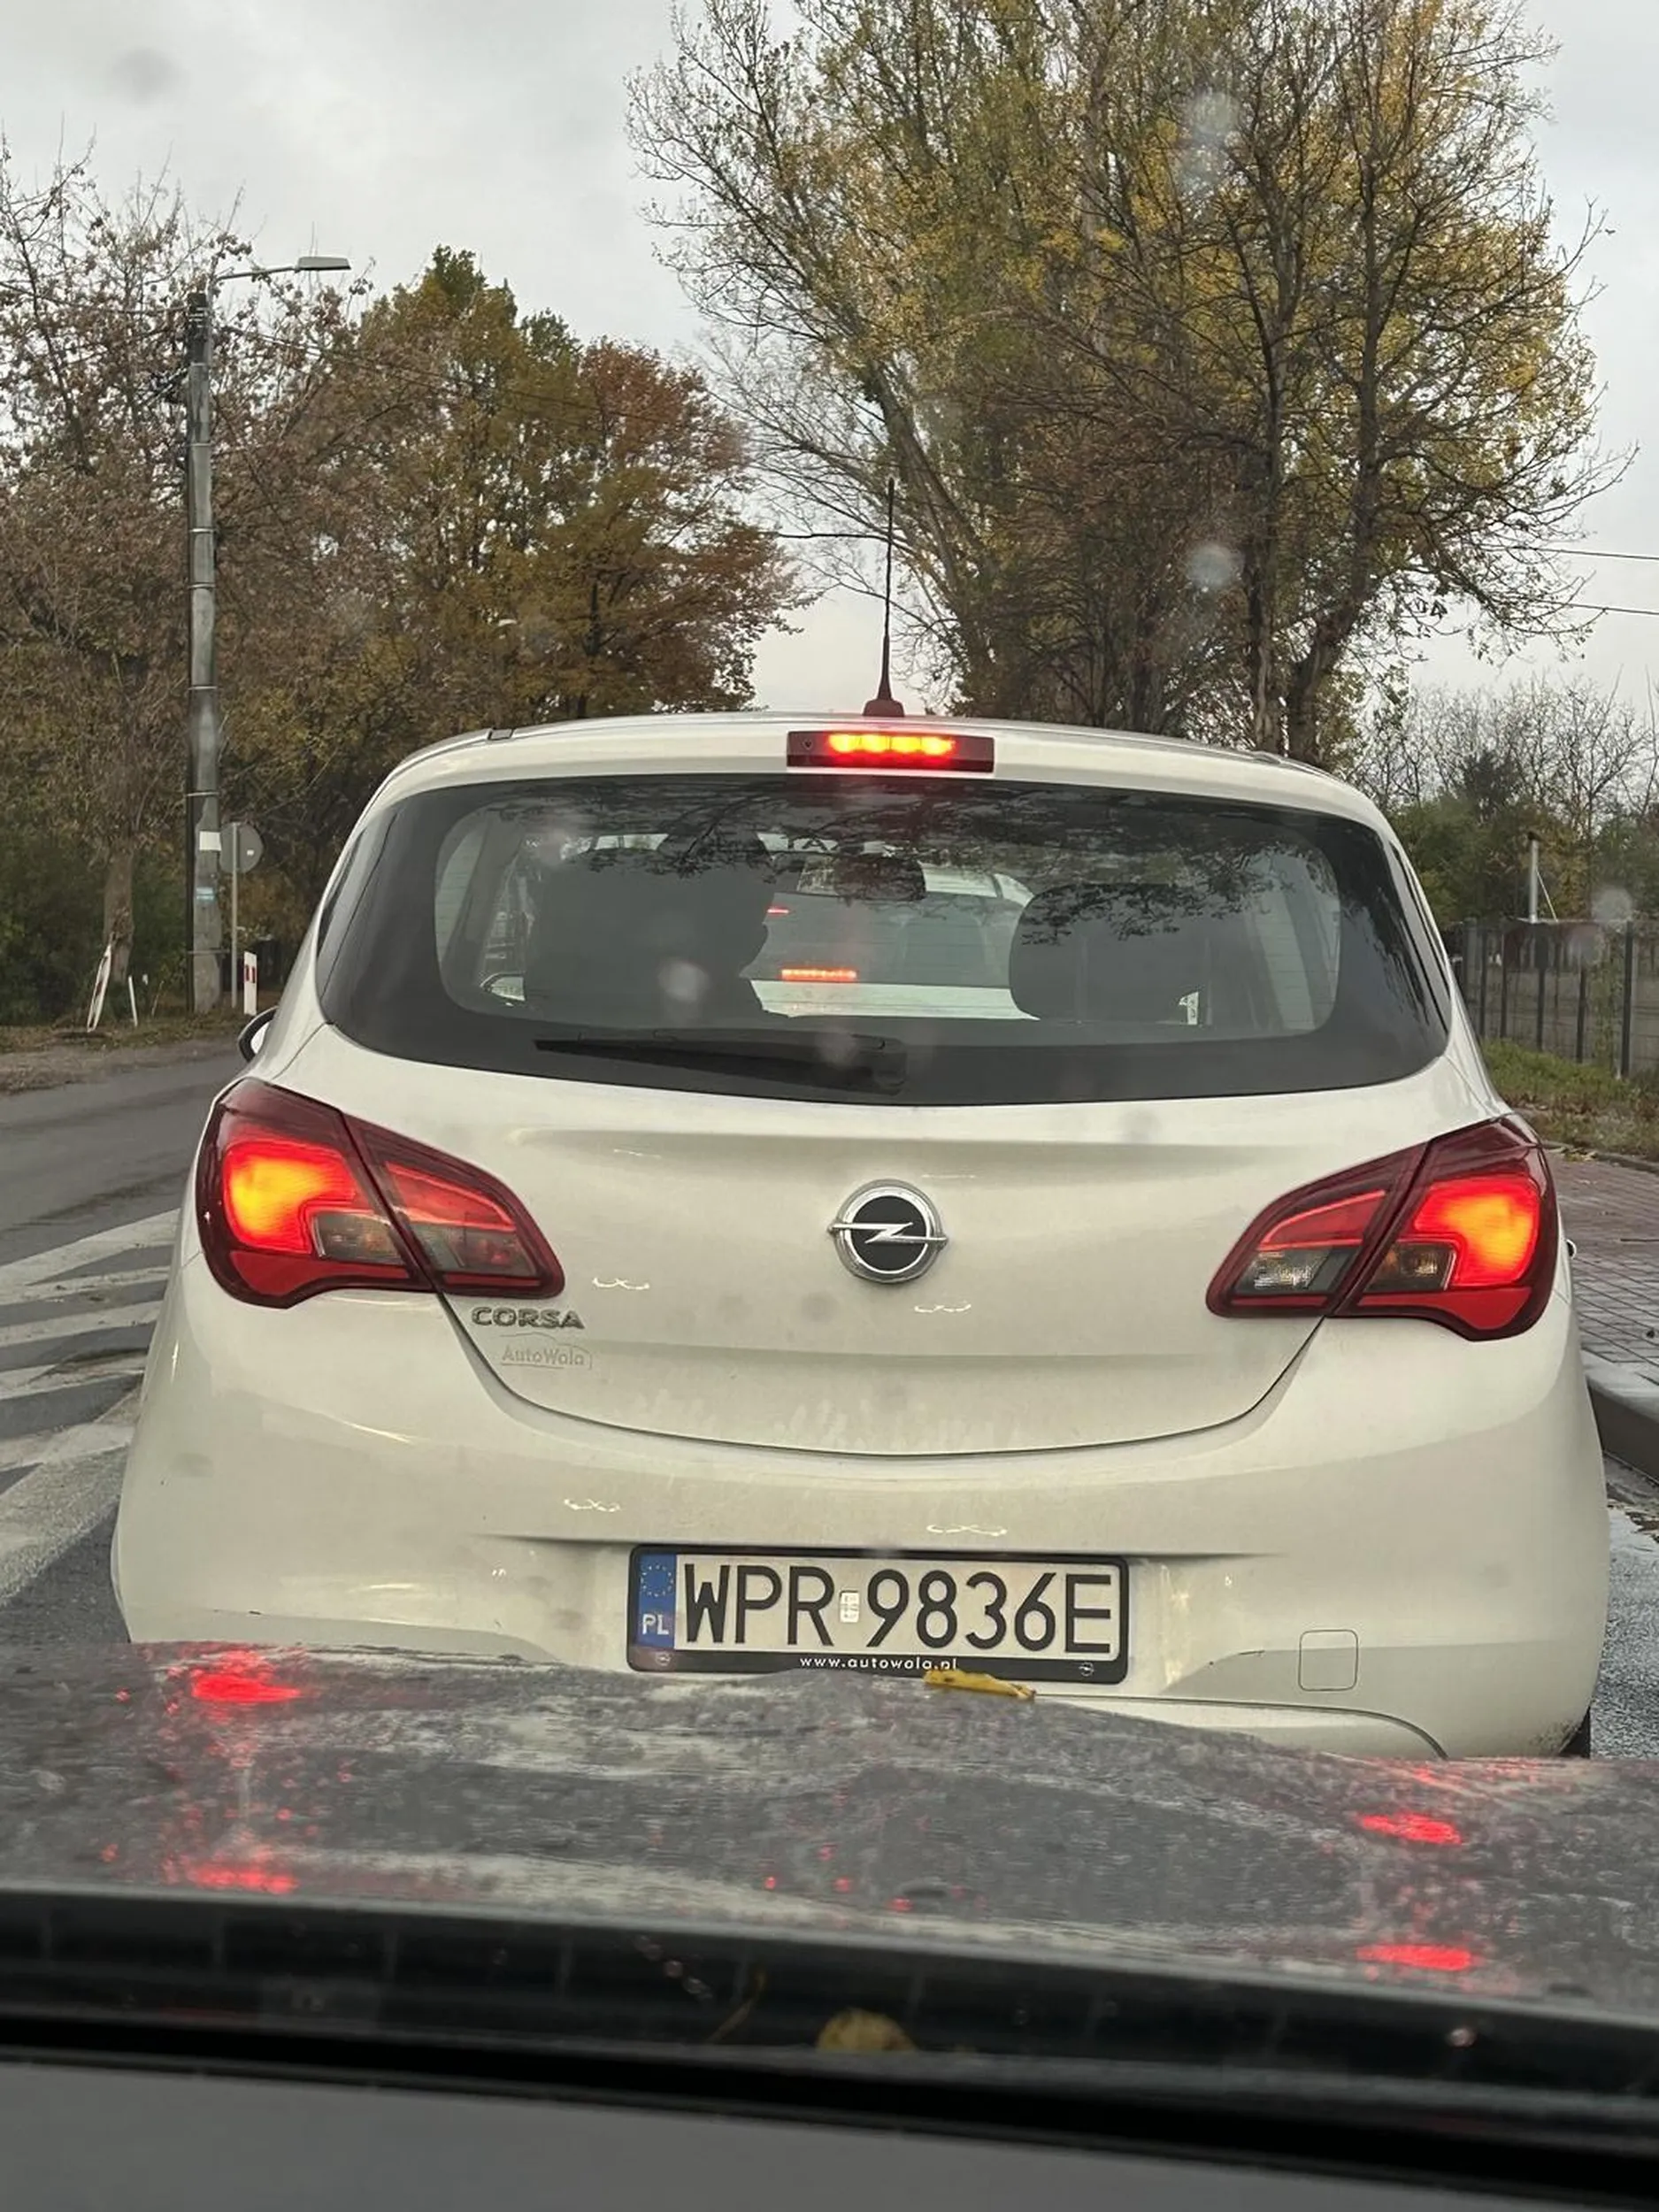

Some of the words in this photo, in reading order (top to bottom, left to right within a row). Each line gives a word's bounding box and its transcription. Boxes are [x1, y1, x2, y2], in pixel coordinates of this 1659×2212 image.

[471, 1306, 586, 1329] CORSA
[684, 1563, 834, 1647] WPR
[866, 1568, 1112, 1654] 9836E
[642, 1613, 670, 1635] PL
